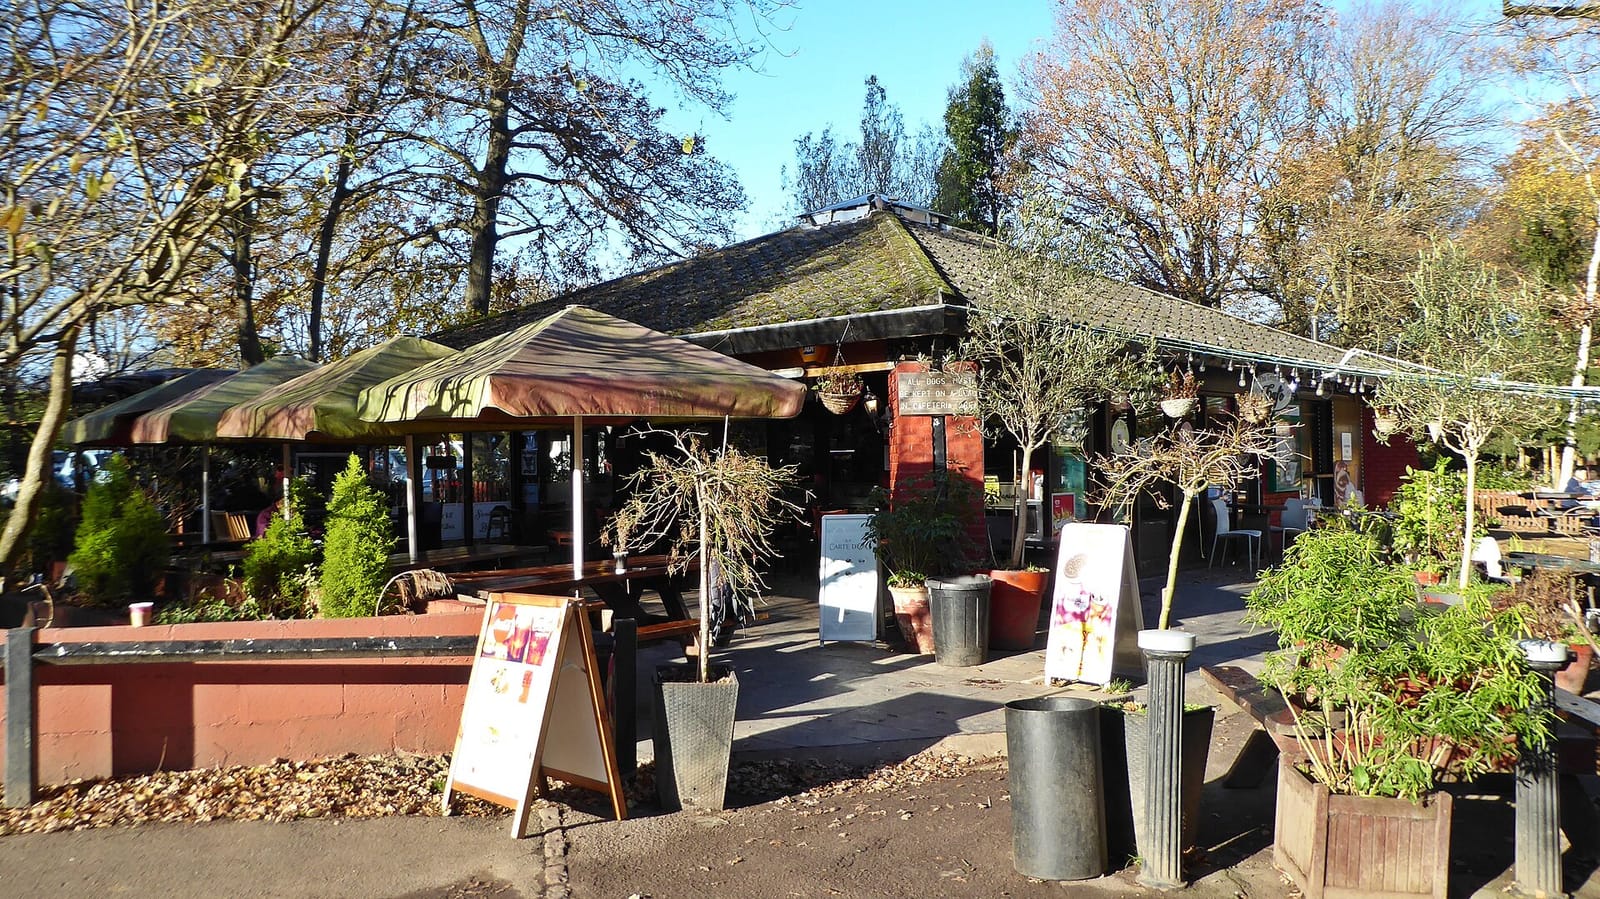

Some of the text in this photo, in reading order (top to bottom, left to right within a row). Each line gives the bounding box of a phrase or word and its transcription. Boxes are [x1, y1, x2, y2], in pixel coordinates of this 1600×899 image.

[907, 378, 920, 386] ALL
[926, 377, 946, 385] DOGS
[899, 390, 909, 398] BE
[912, 390, 931, 398] KEPT
[935, 389, 946, 398] ON
[913, 401, 952, 410] CAFETERIA
